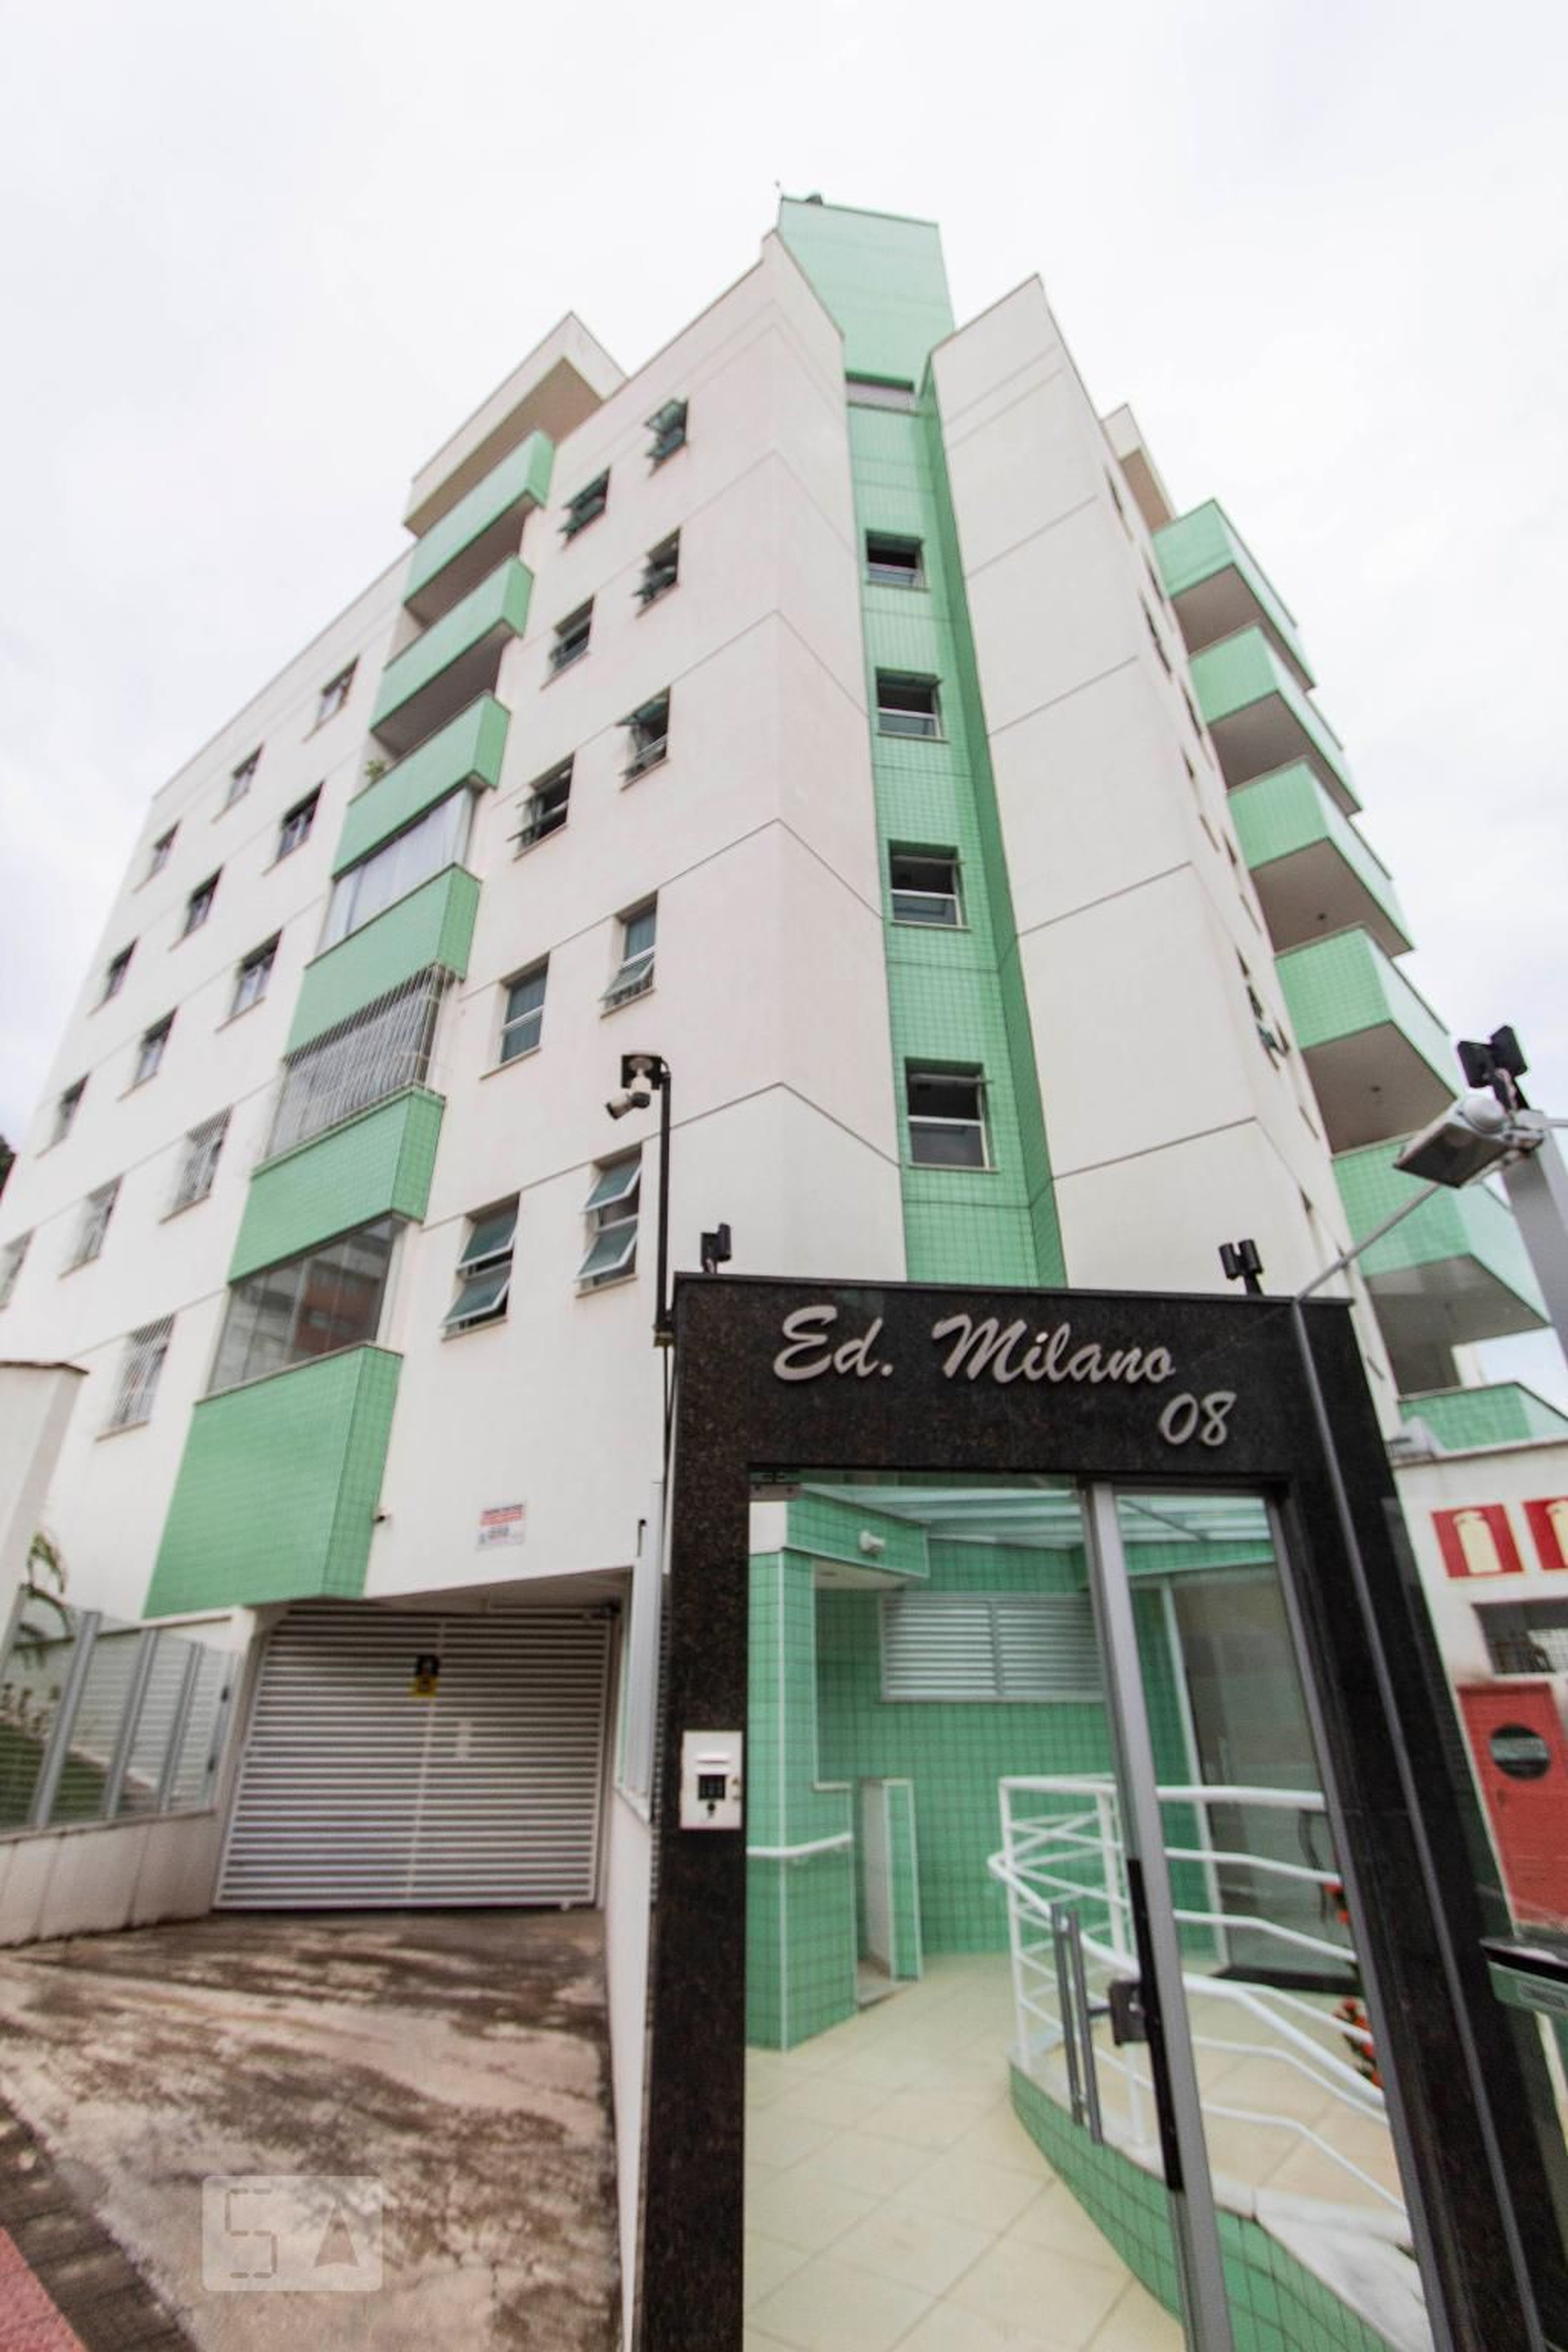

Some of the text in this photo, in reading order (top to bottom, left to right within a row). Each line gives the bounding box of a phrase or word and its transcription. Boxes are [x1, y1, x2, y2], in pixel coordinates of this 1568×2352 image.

[774, 1305, 1176, 1383] Ed. Milano
[1159, 1391, 1236, 1446] 08
